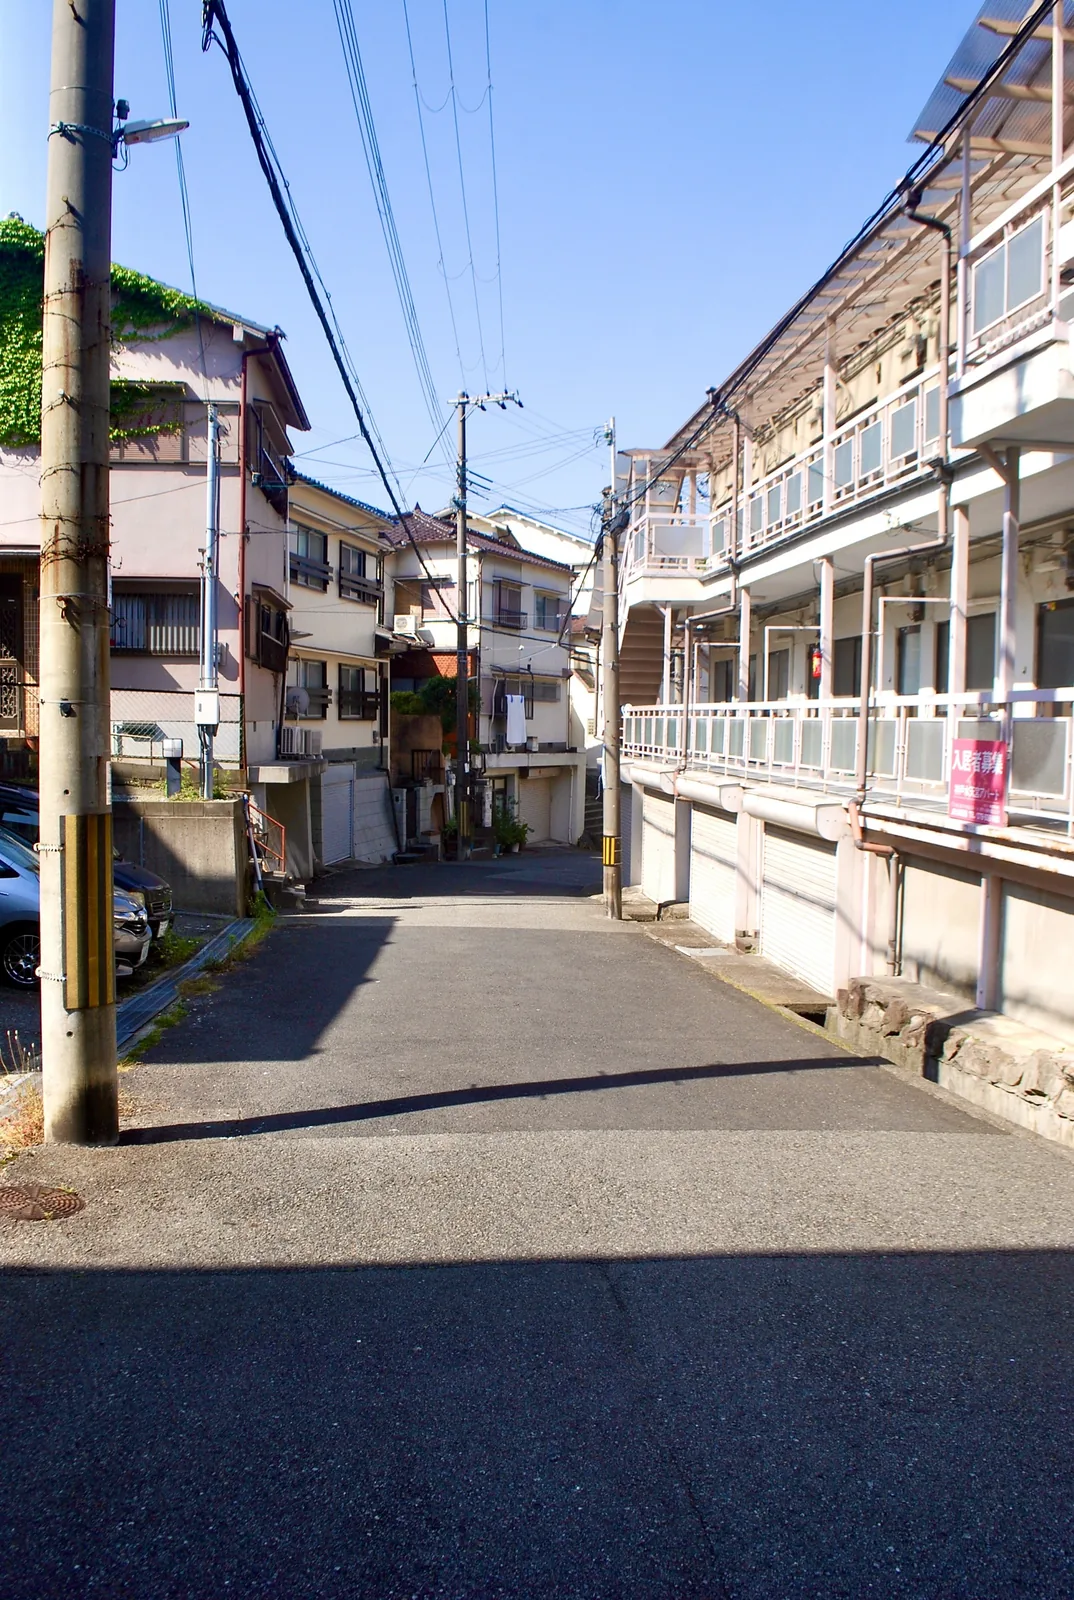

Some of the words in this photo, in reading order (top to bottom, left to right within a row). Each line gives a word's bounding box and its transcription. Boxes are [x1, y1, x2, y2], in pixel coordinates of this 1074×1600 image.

[952, 750, 1003, 775] 入居者募集
